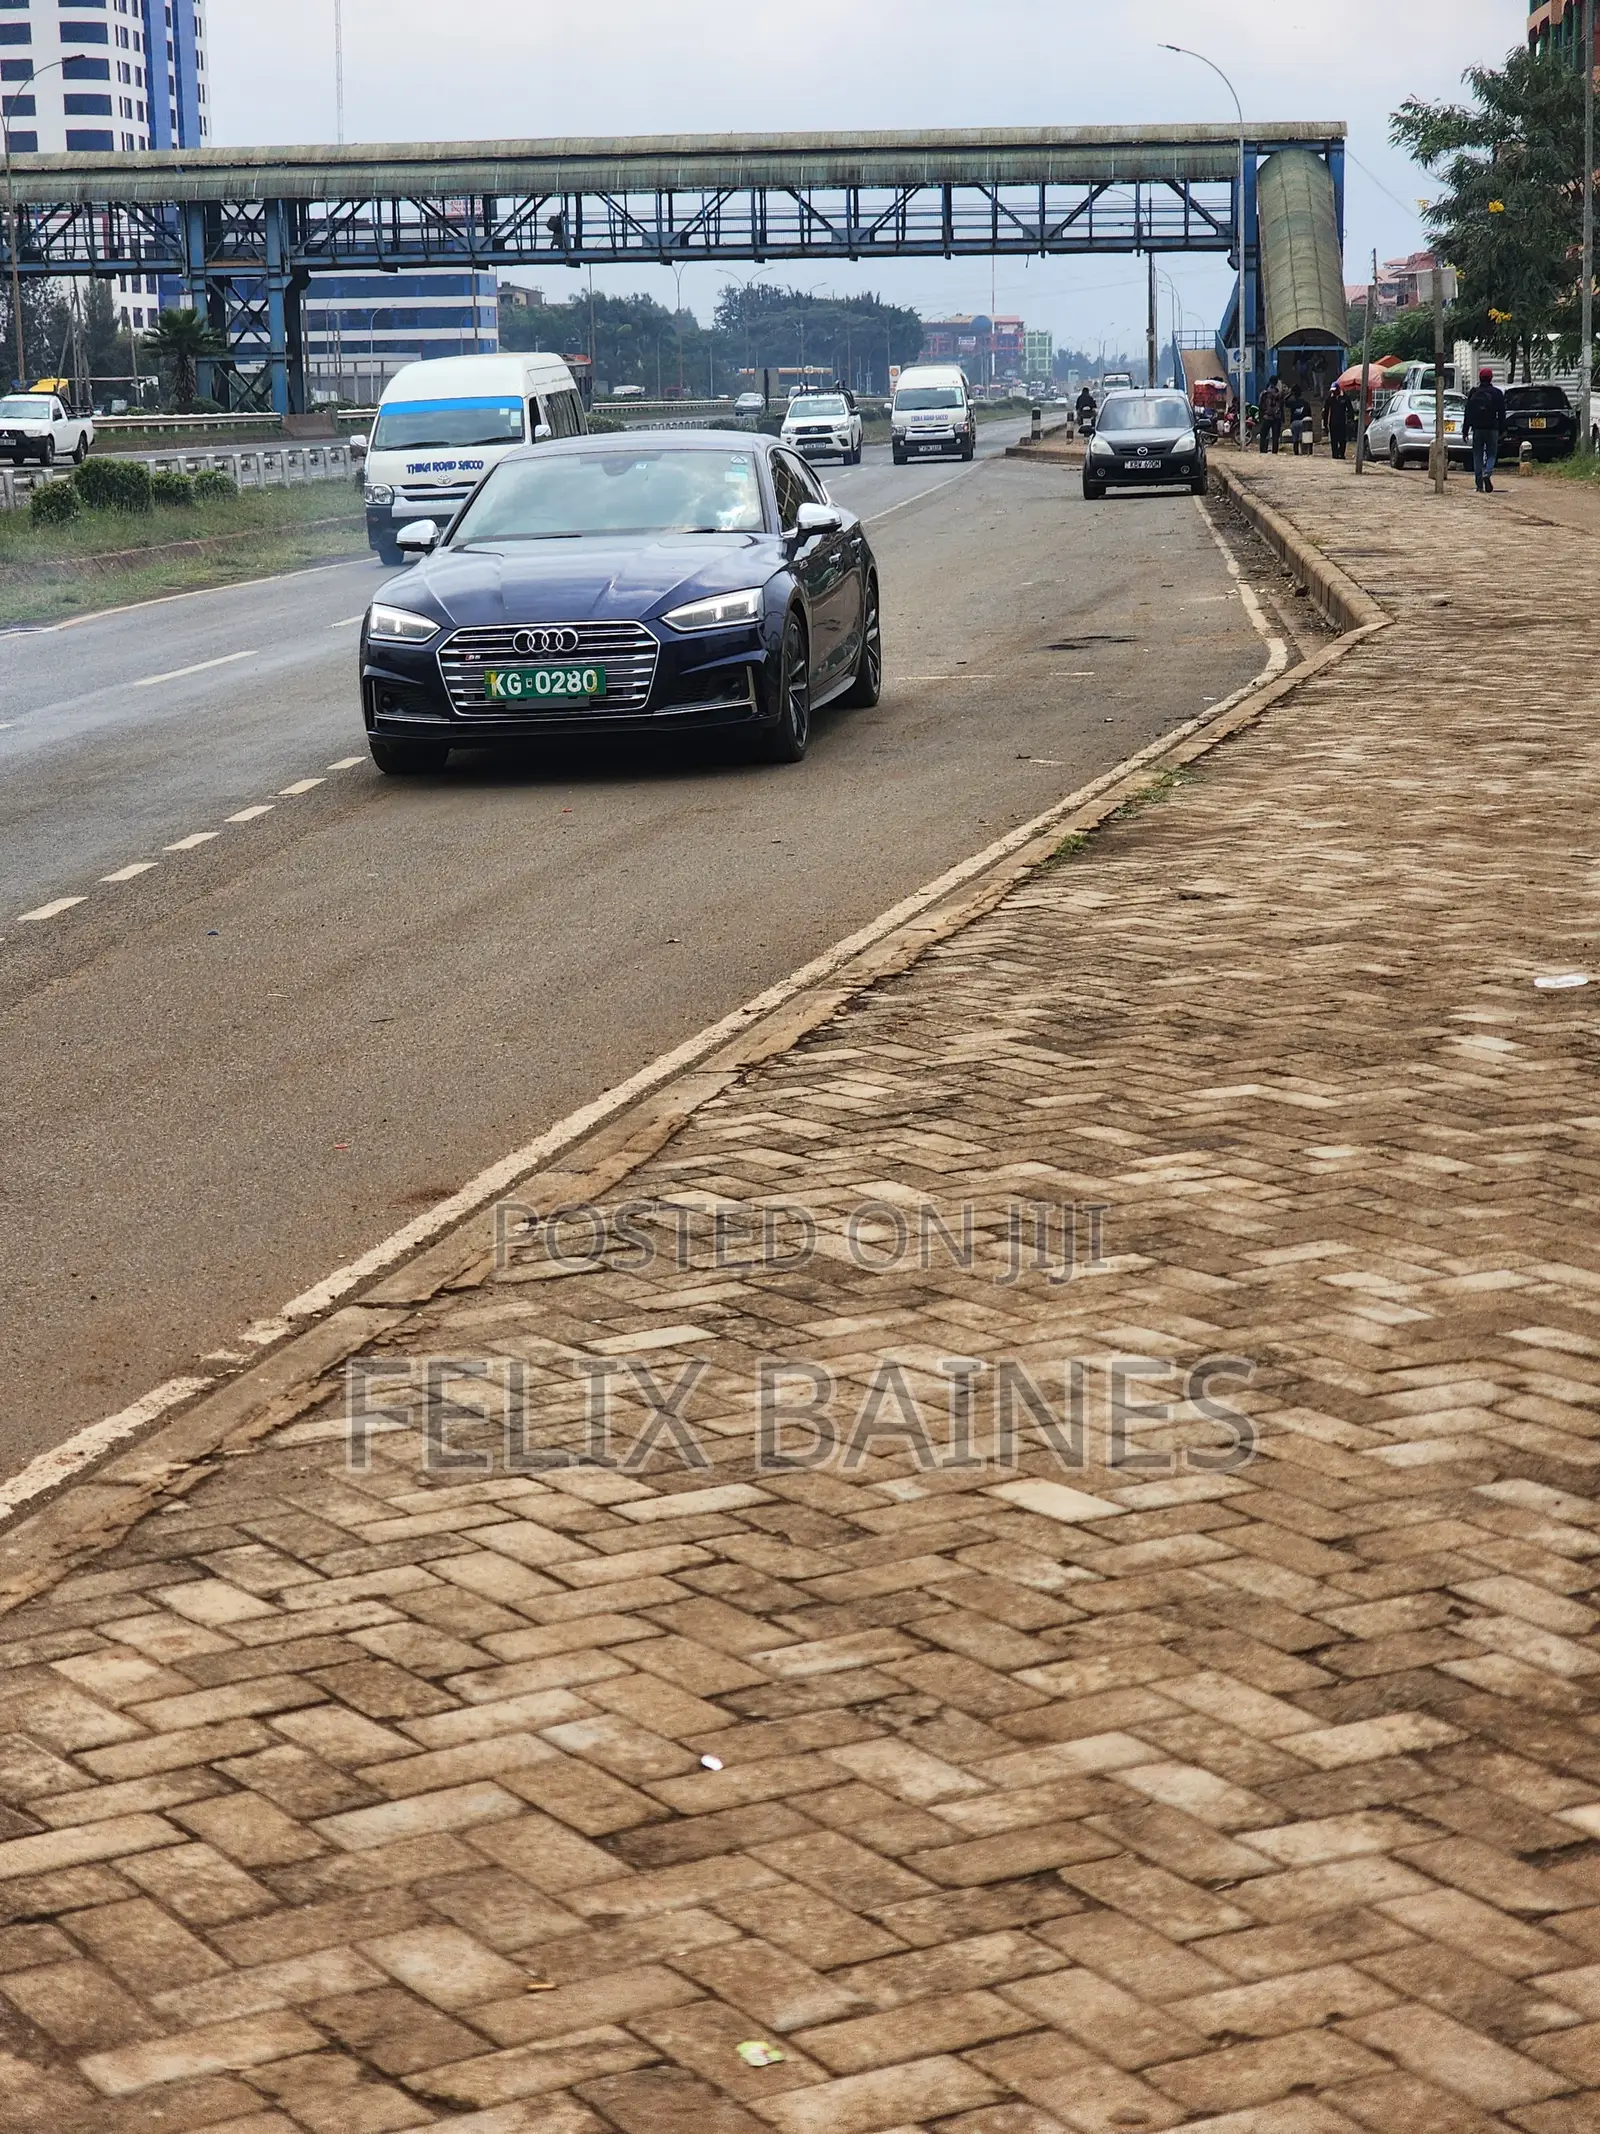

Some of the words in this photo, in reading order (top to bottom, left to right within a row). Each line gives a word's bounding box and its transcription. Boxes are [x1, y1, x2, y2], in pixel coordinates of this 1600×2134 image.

[406, 462, 431, 474] THIKA
[432, 460, 456, 472] ROAD
[458, 460, 484, 470] SACCO
